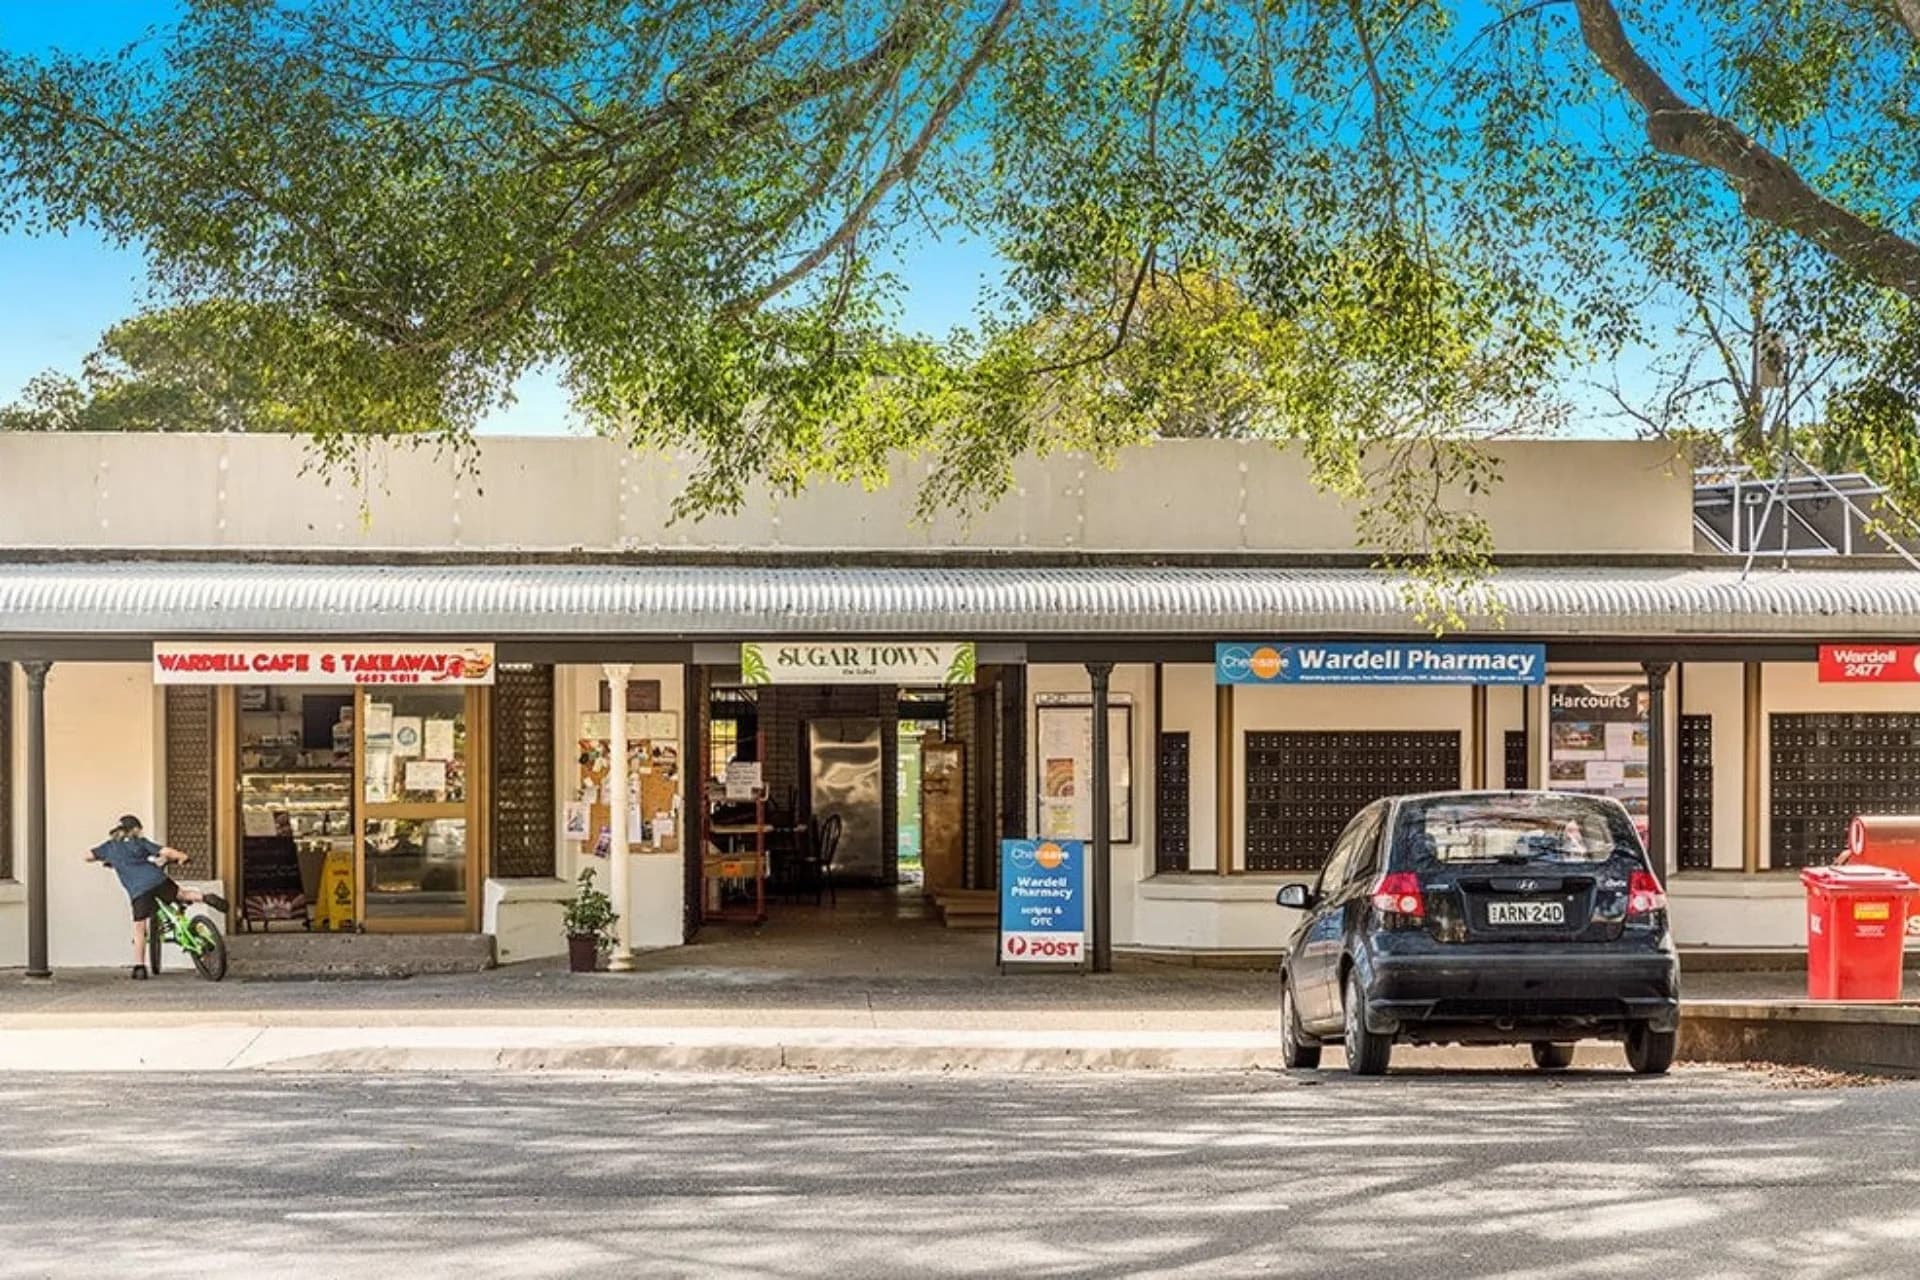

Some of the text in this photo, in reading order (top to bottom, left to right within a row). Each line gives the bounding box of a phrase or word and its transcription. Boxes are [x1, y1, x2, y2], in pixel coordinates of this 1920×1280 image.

[157, 653, 448, 673] WARDELL CAFE & TAKEAWAY
[777, 647, 940, 667] SUGAR TOWN
[1298, 649, 1536, 675] Wardell Pharmacy
[1833, 650, 1896, 663] Wardell
[1844, 664, 1884, 677] 2477
[1551, 694, 1631, 708] Harcourts
[1017, 877, 1067, 887] Wardell
[1011, 887, 1072, 900] Pharmacy
[1054, 906, 1063, 915] &
[1031, 917, 1052, 926] OTC
[1031, 942, 1079, 956] POST
